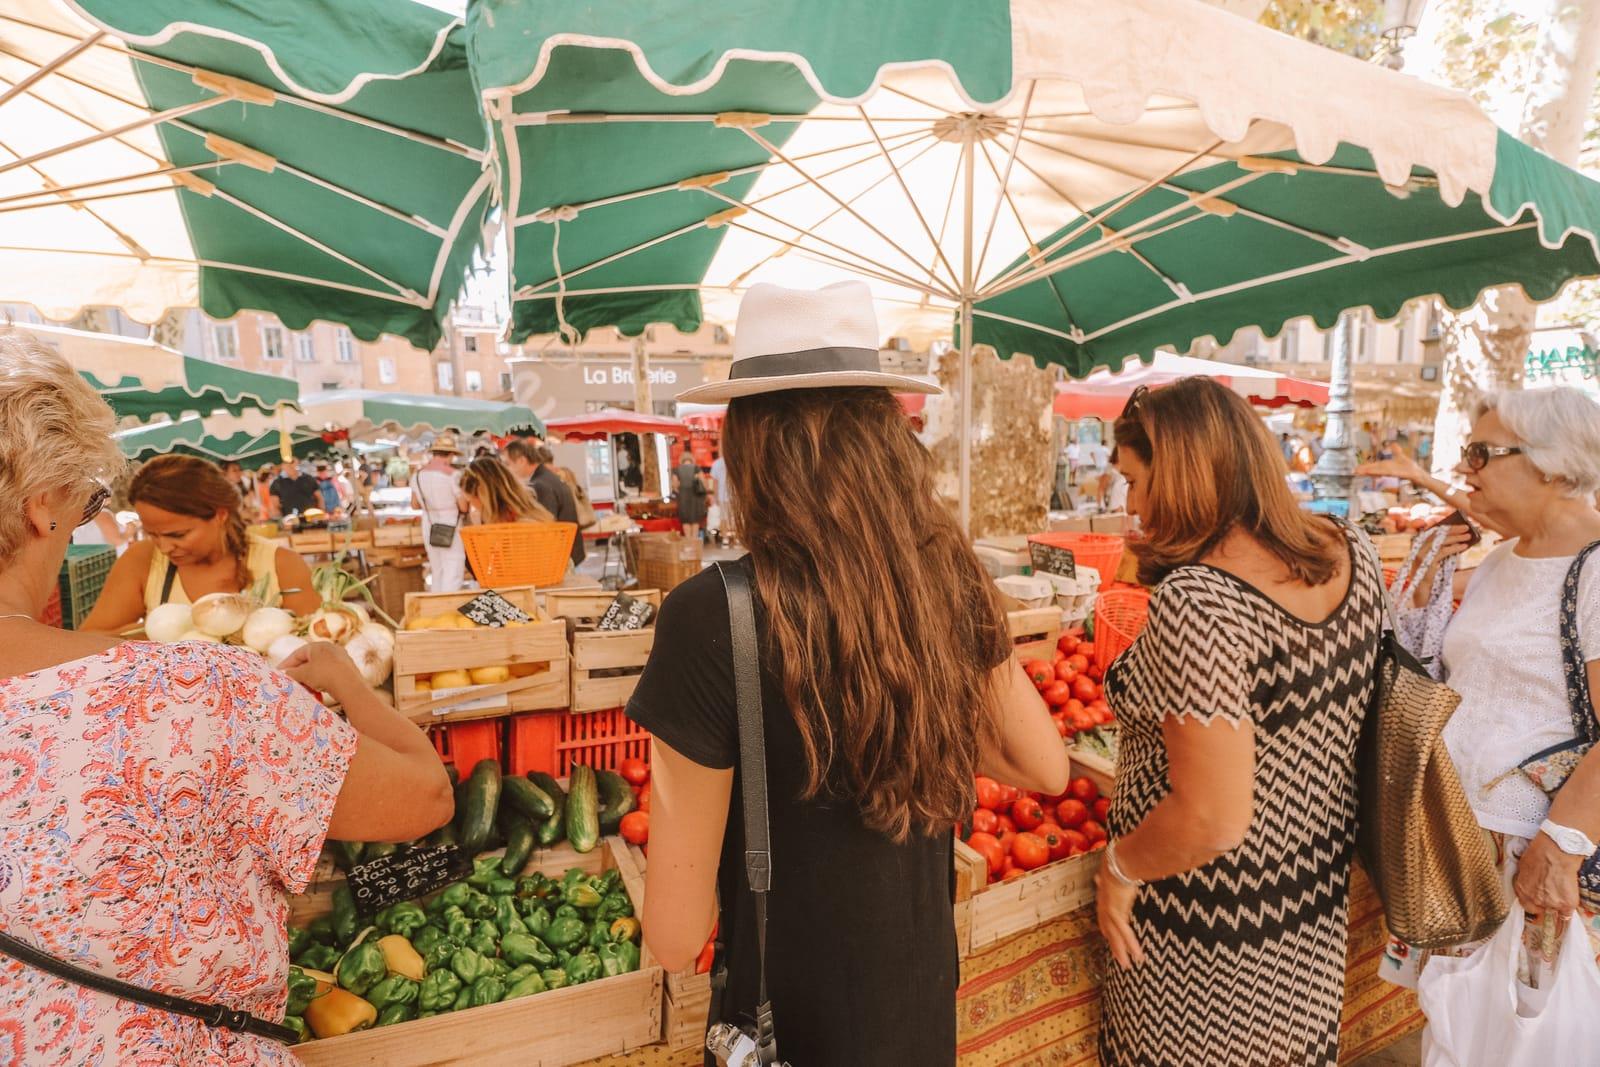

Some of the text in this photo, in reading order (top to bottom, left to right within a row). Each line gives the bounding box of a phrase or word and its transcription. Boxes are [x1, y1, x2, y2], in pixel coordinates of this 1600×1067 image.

[1525, 344, 1600, 368] HARM
[583, 366, 677, 384] La Brerie
